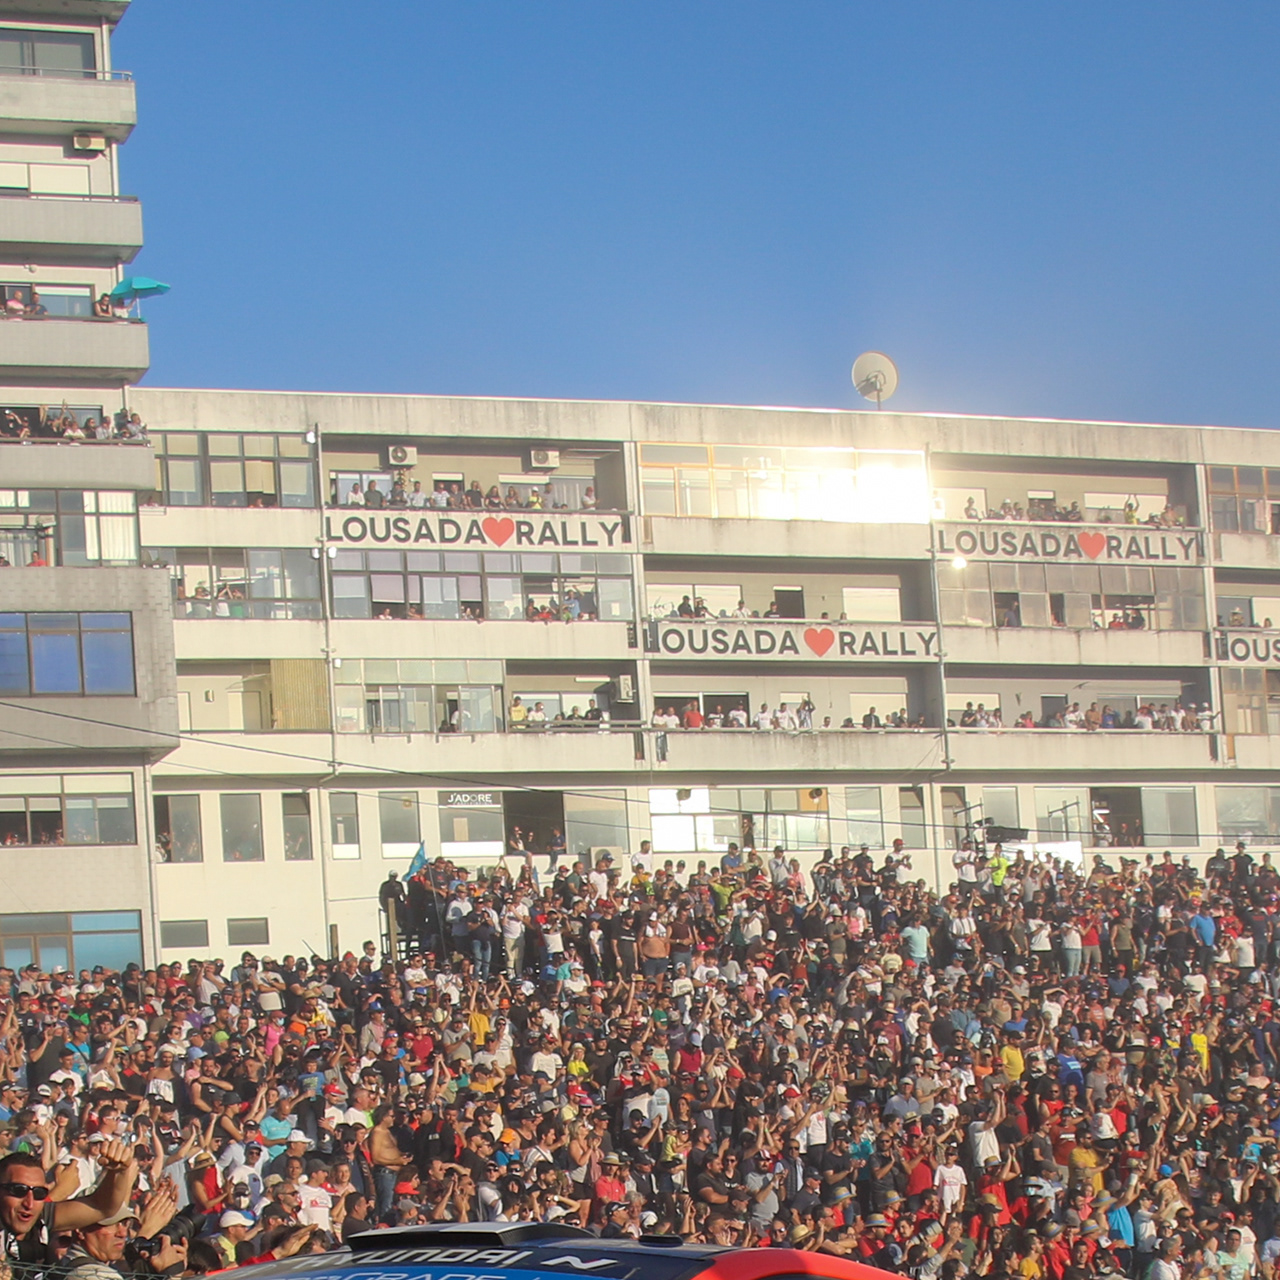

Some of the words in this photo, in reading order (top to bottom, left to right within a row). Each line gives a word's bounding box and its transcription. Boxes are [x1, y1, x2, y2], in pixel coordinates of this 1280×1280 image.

[325, 516, 488, 545] LOUSADA
[516, 519, 621, 547] RALLY
[938, 529, 1083, 558] LOUSADA
[1106, 534, 1195, 560] RALLY
[838, 630, 937, 656] RALLY
[447, 793, 492, 804] J'ADORE
[293, 1249, 533, 1270] HYUNDAI
